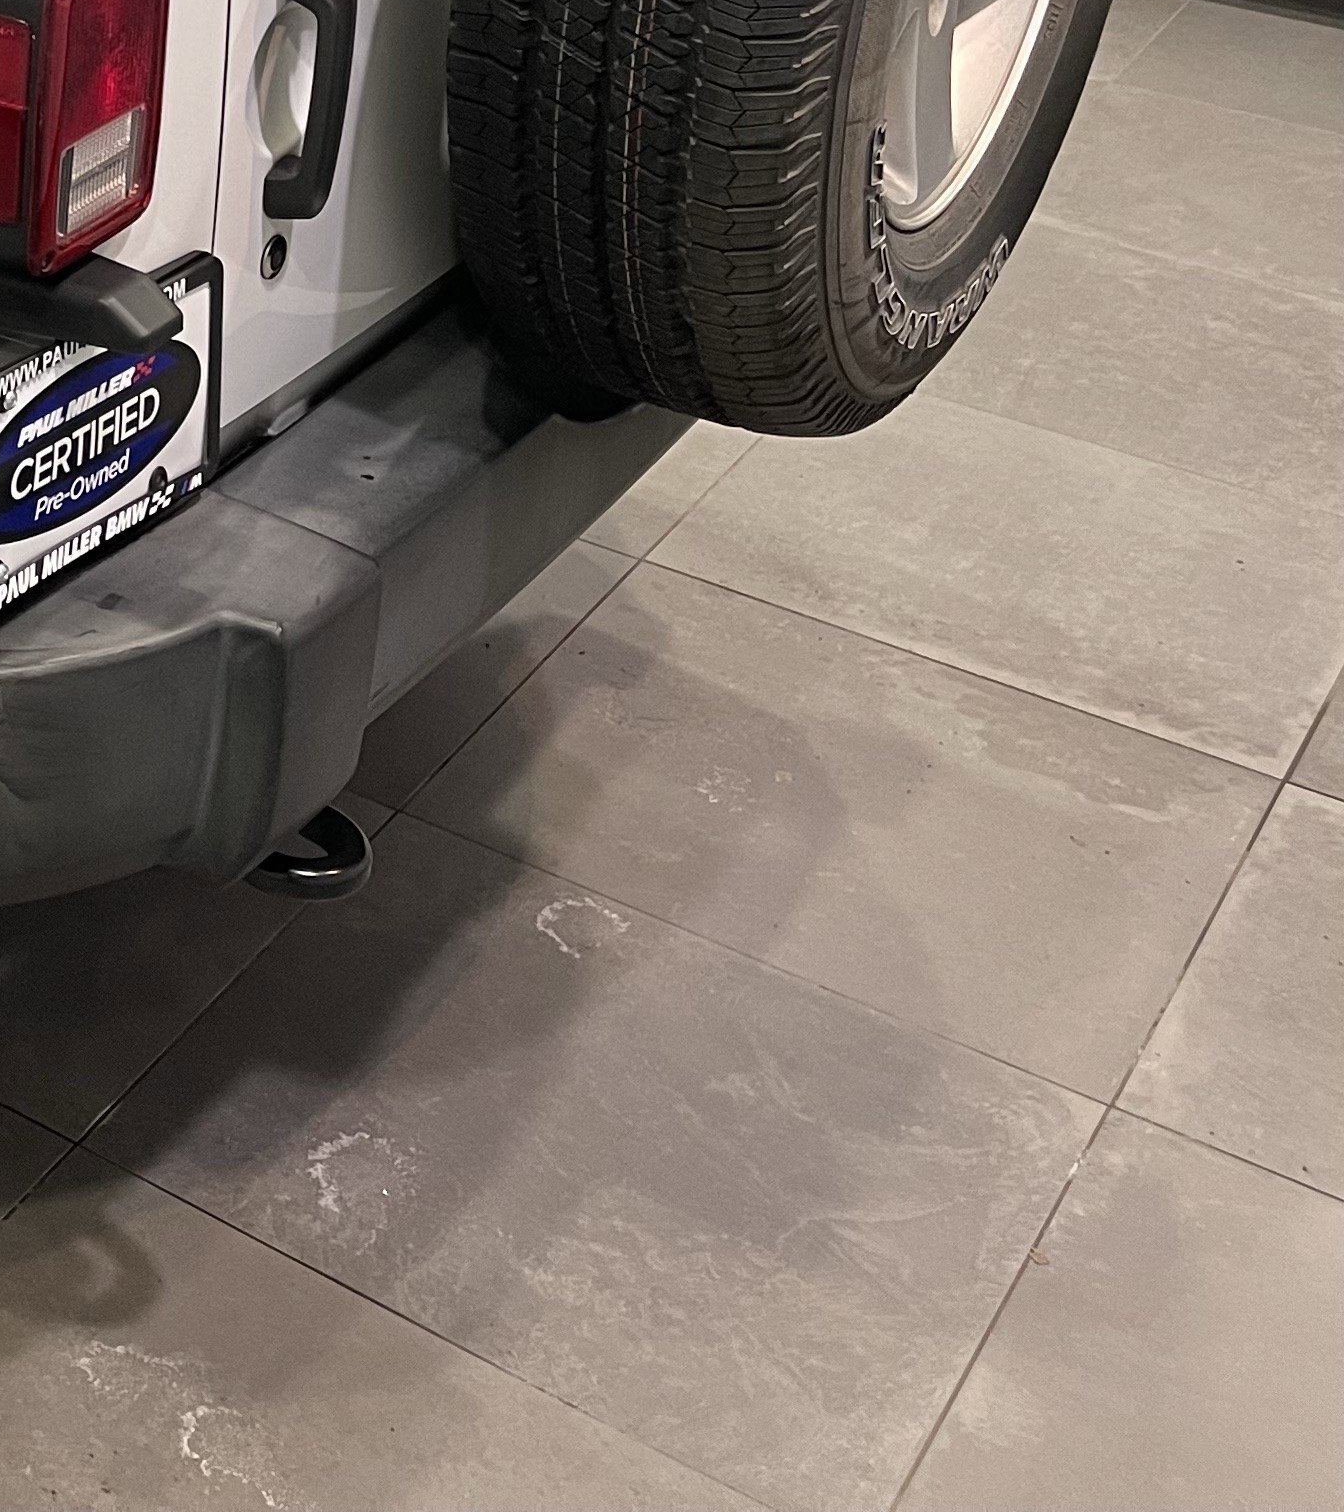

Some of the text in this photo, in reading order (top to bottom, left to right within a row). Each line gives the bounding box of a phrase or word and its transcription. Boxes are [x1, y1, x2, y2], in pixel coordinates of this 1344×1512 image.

[10, 387, 161, 500] CERTIFIED
[17, 366, 136, 449] PAUL MILLER
[34, 447, 131, 522] Pre-Owned
[42, 524, 103, 580] MILLER
[105, 496, 150, 541] BMW
